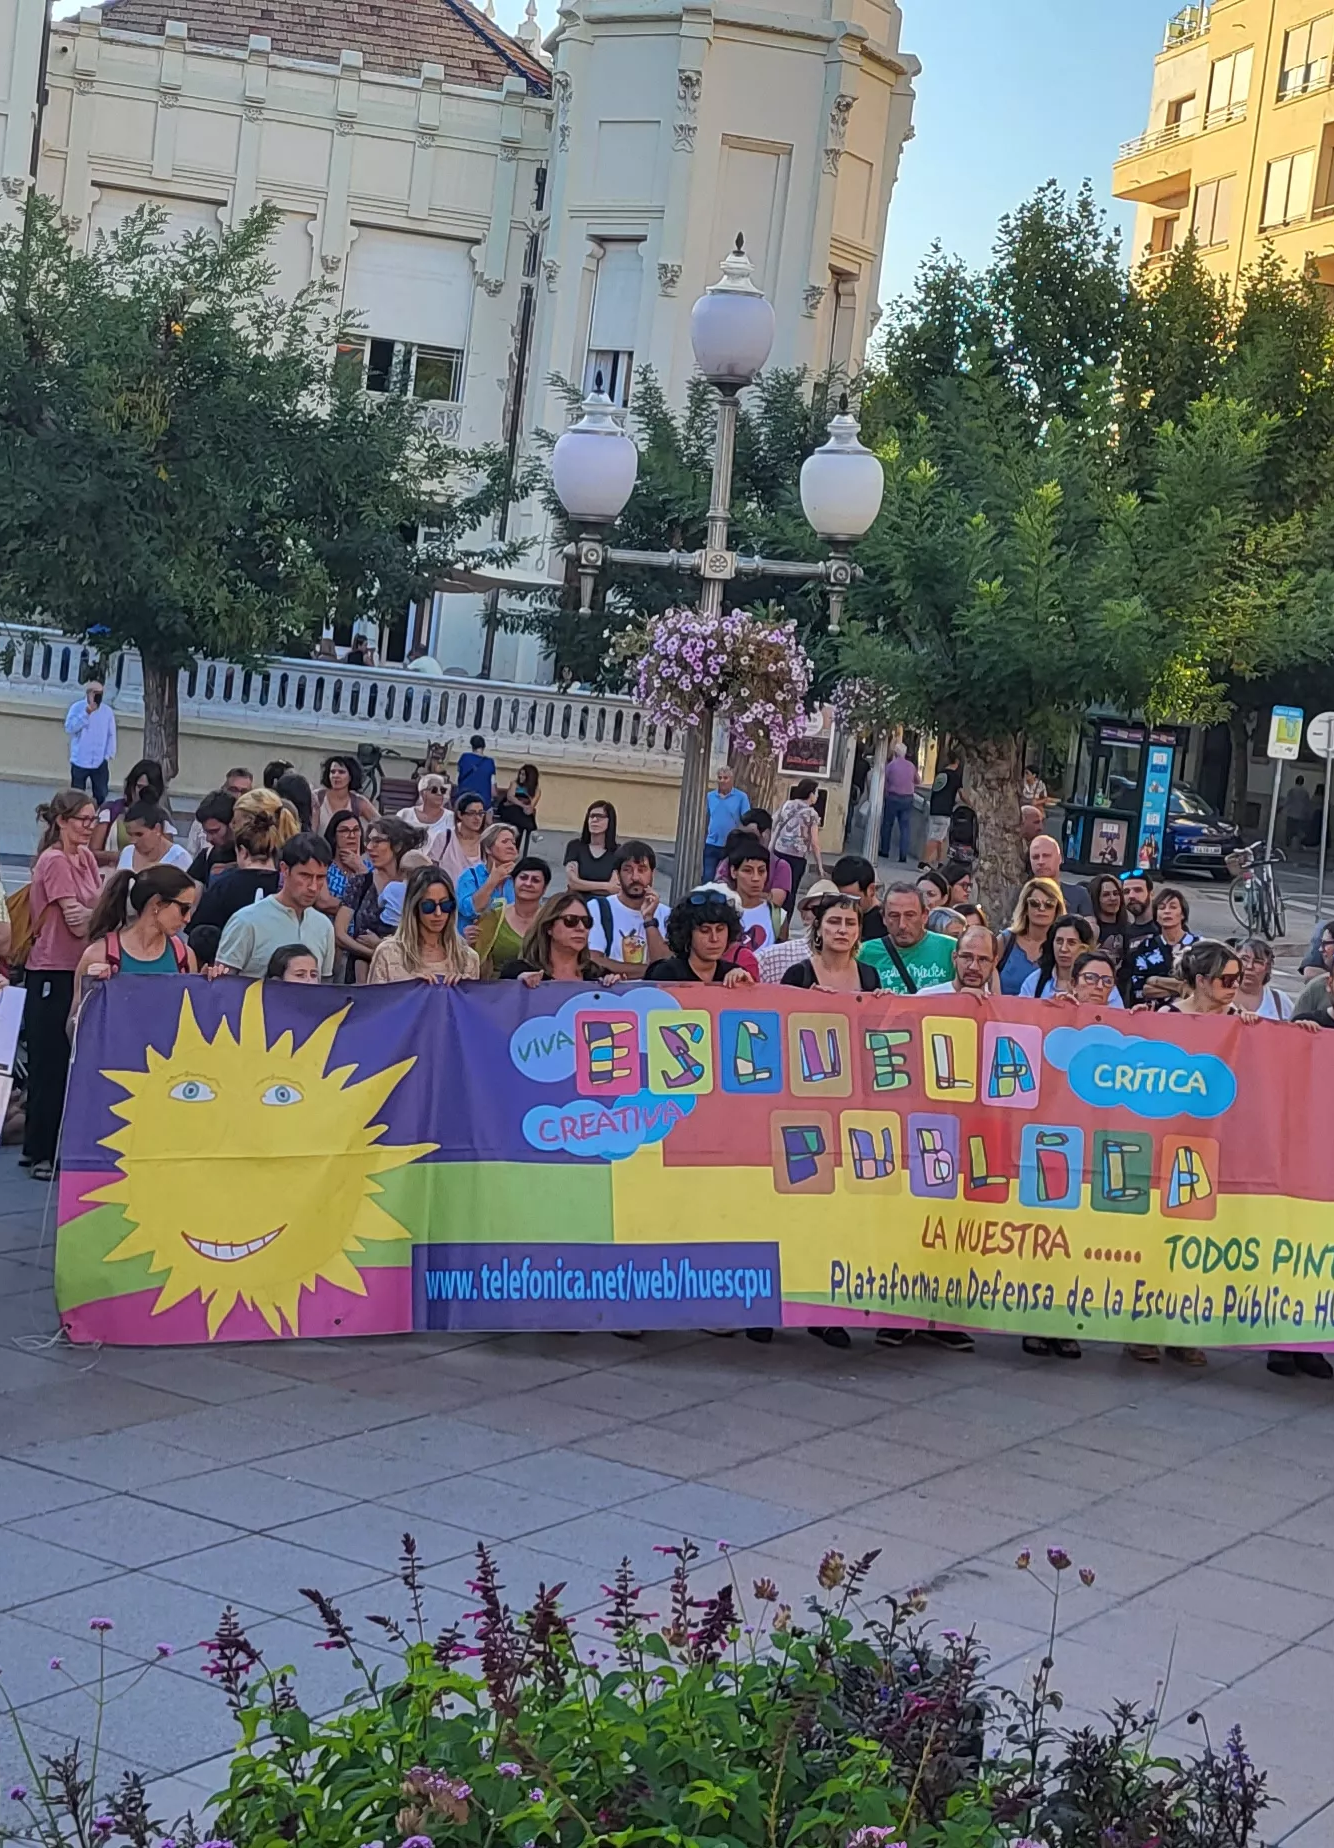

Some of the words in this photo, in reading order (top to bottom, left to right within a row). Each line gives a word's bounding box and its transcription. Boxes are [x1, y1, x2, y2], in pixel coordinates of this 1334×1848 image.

[517, 1030, 575, 1063] VIVA
[581, 1020, 1037, 1098] ESCUELA
[1093, 1061, 1208, 1098] CRÍTICA
[538, 1099, 687, 1143] CREATIVA
[921, 1214, 947, 1250] LA
[955, 1217, 1071, 1261] NUESTRA
[1163, 1234, 1261, 1274] TODOS
[830, 1260, 939, 1306] Plataforma
[945, 1276, 963, 1309] en
[966, 1267, 1055, 1314] Defensa
[1067, 1275, 1095, 1318] de
[1103, 1277, 1124, 1321] la
[1131, 1279, 1214, 1326] Escuela
[1222, 1284, 1304, 1329] Pública
